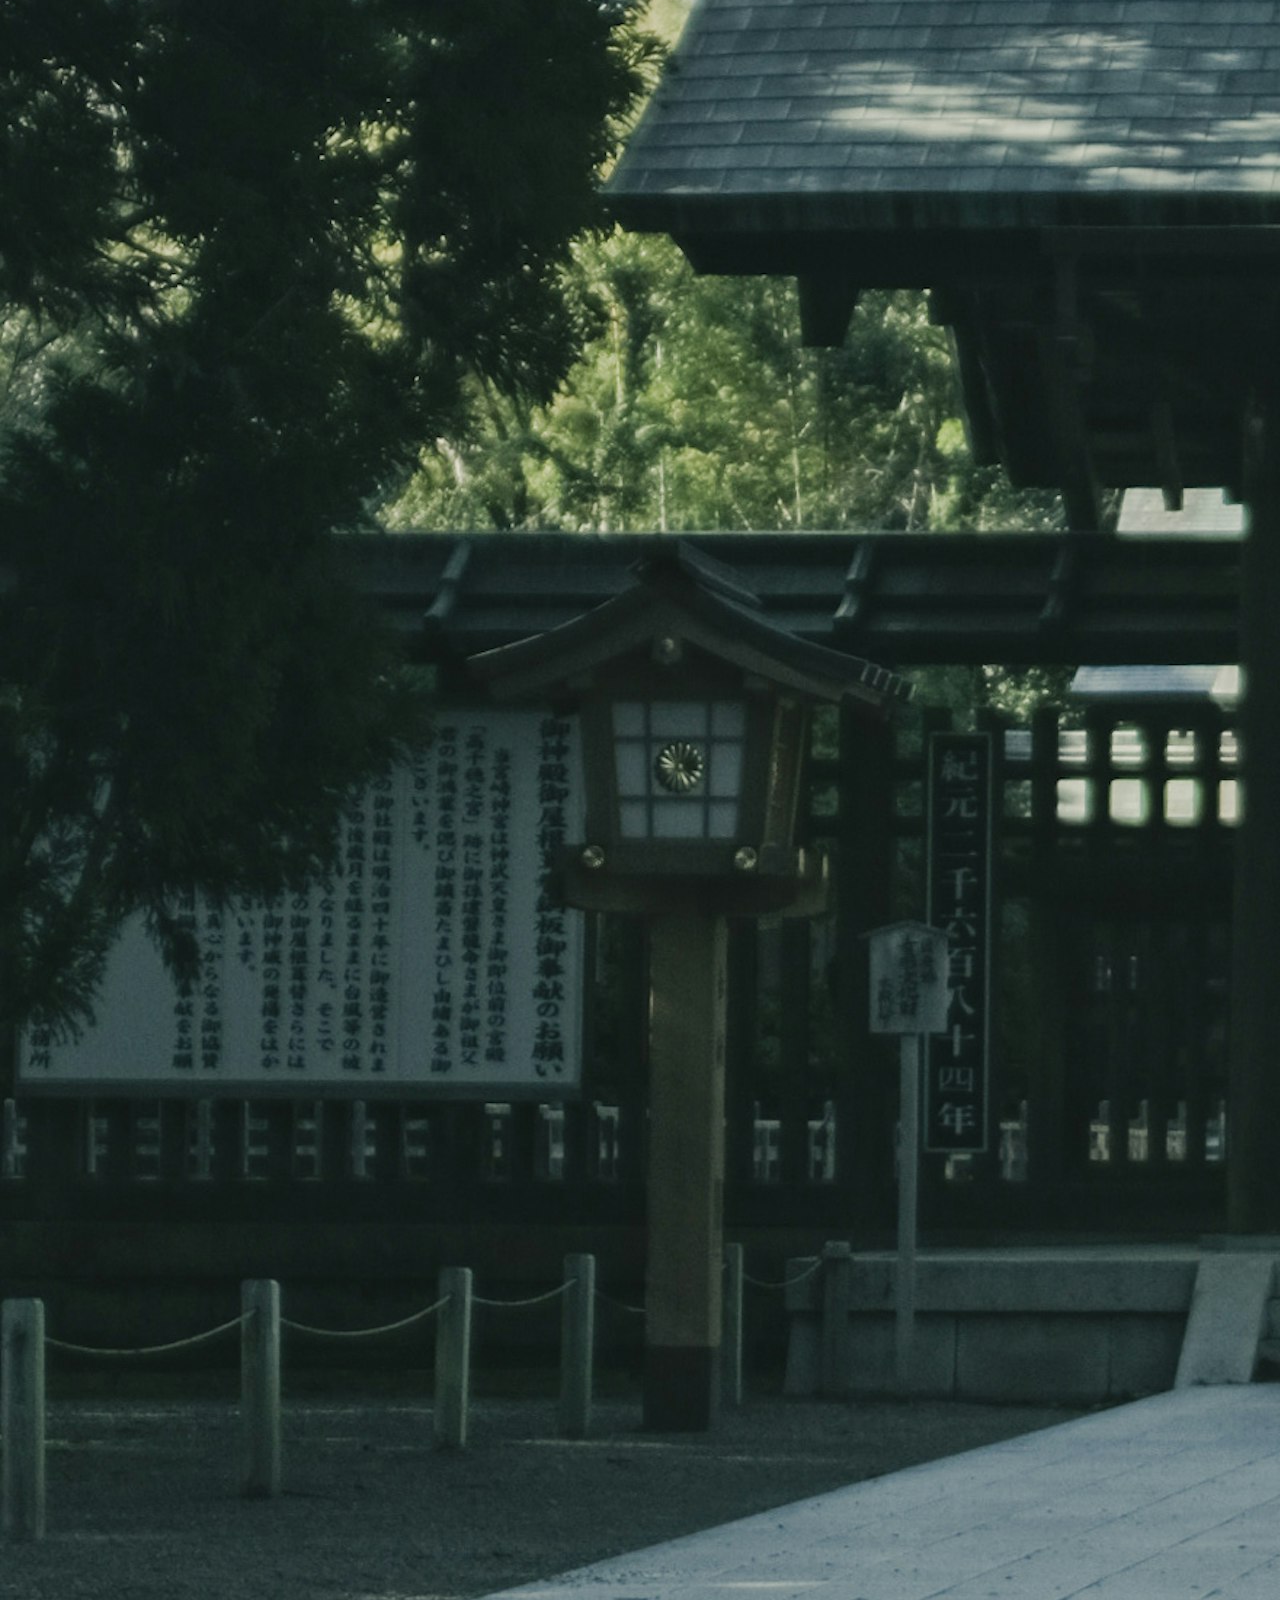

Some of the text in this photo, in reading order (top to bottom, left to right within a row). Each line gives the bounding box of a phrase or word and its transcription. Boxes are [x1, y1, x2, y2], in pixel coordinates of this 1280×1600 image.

[937, 748, 979, 1136] 紀元二千六百八十四年
